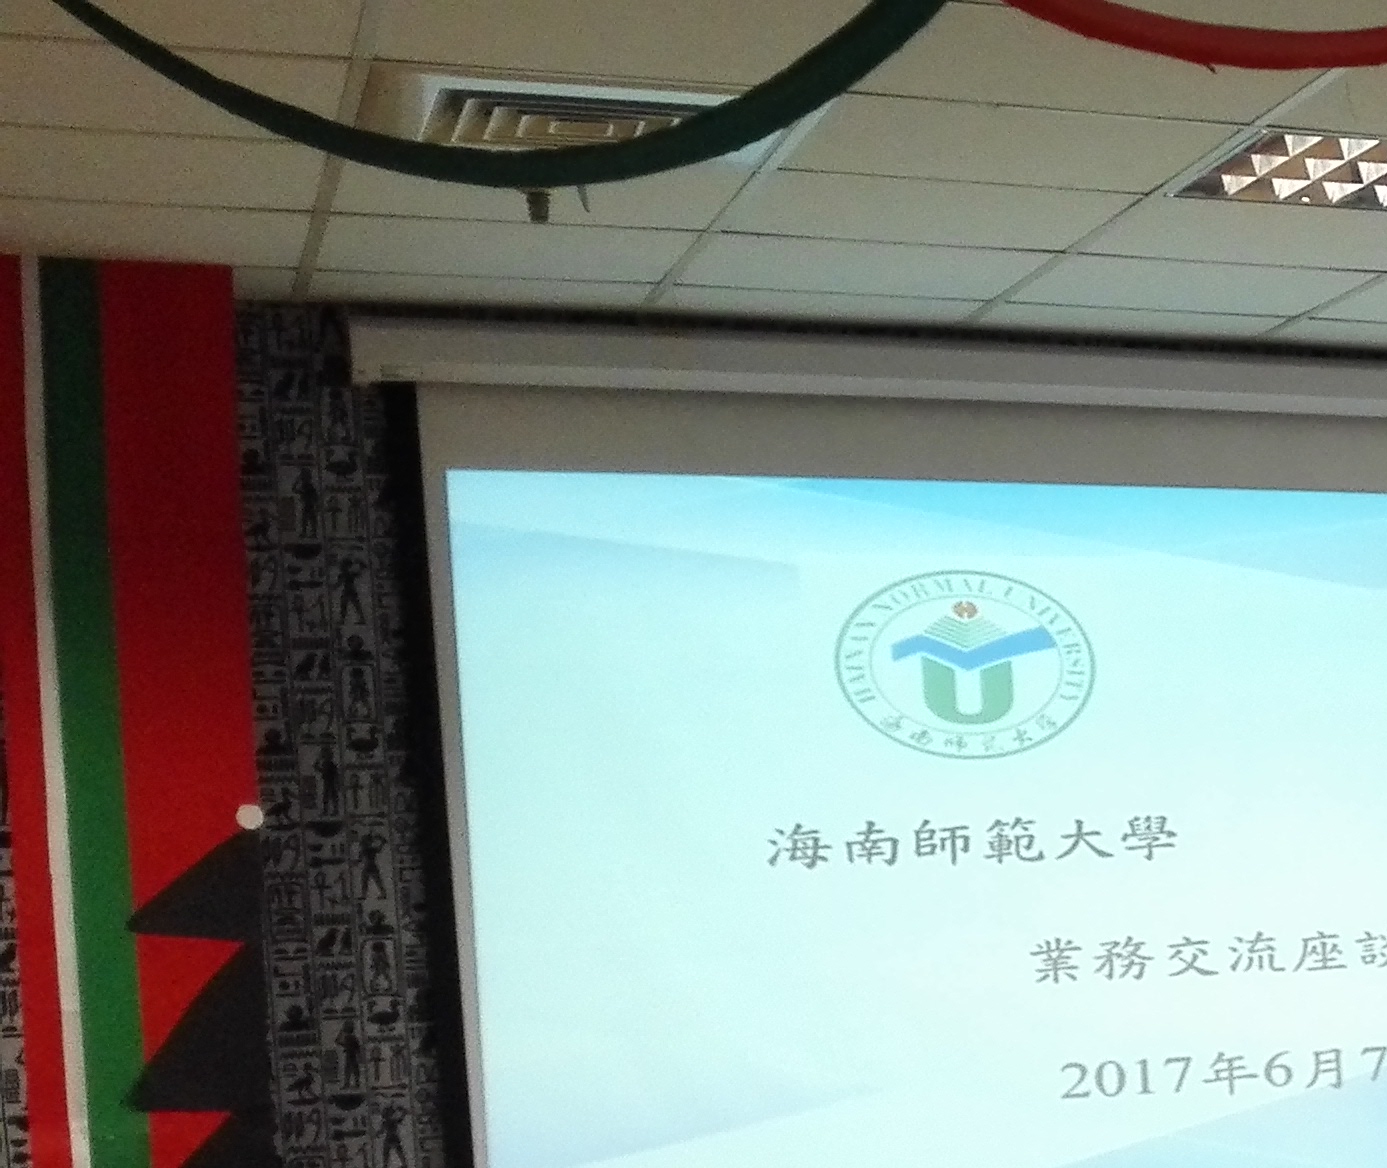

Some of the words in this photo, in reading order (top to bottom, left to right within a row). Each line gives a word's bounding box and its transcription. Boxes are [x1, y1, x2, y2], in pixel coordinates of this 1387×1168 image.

[871, 578, 993, 612] NORMAL
[1003, 585, 1086, 702] UNIVERSITY
[766, 814, 1178, 870] 海南師範大學
